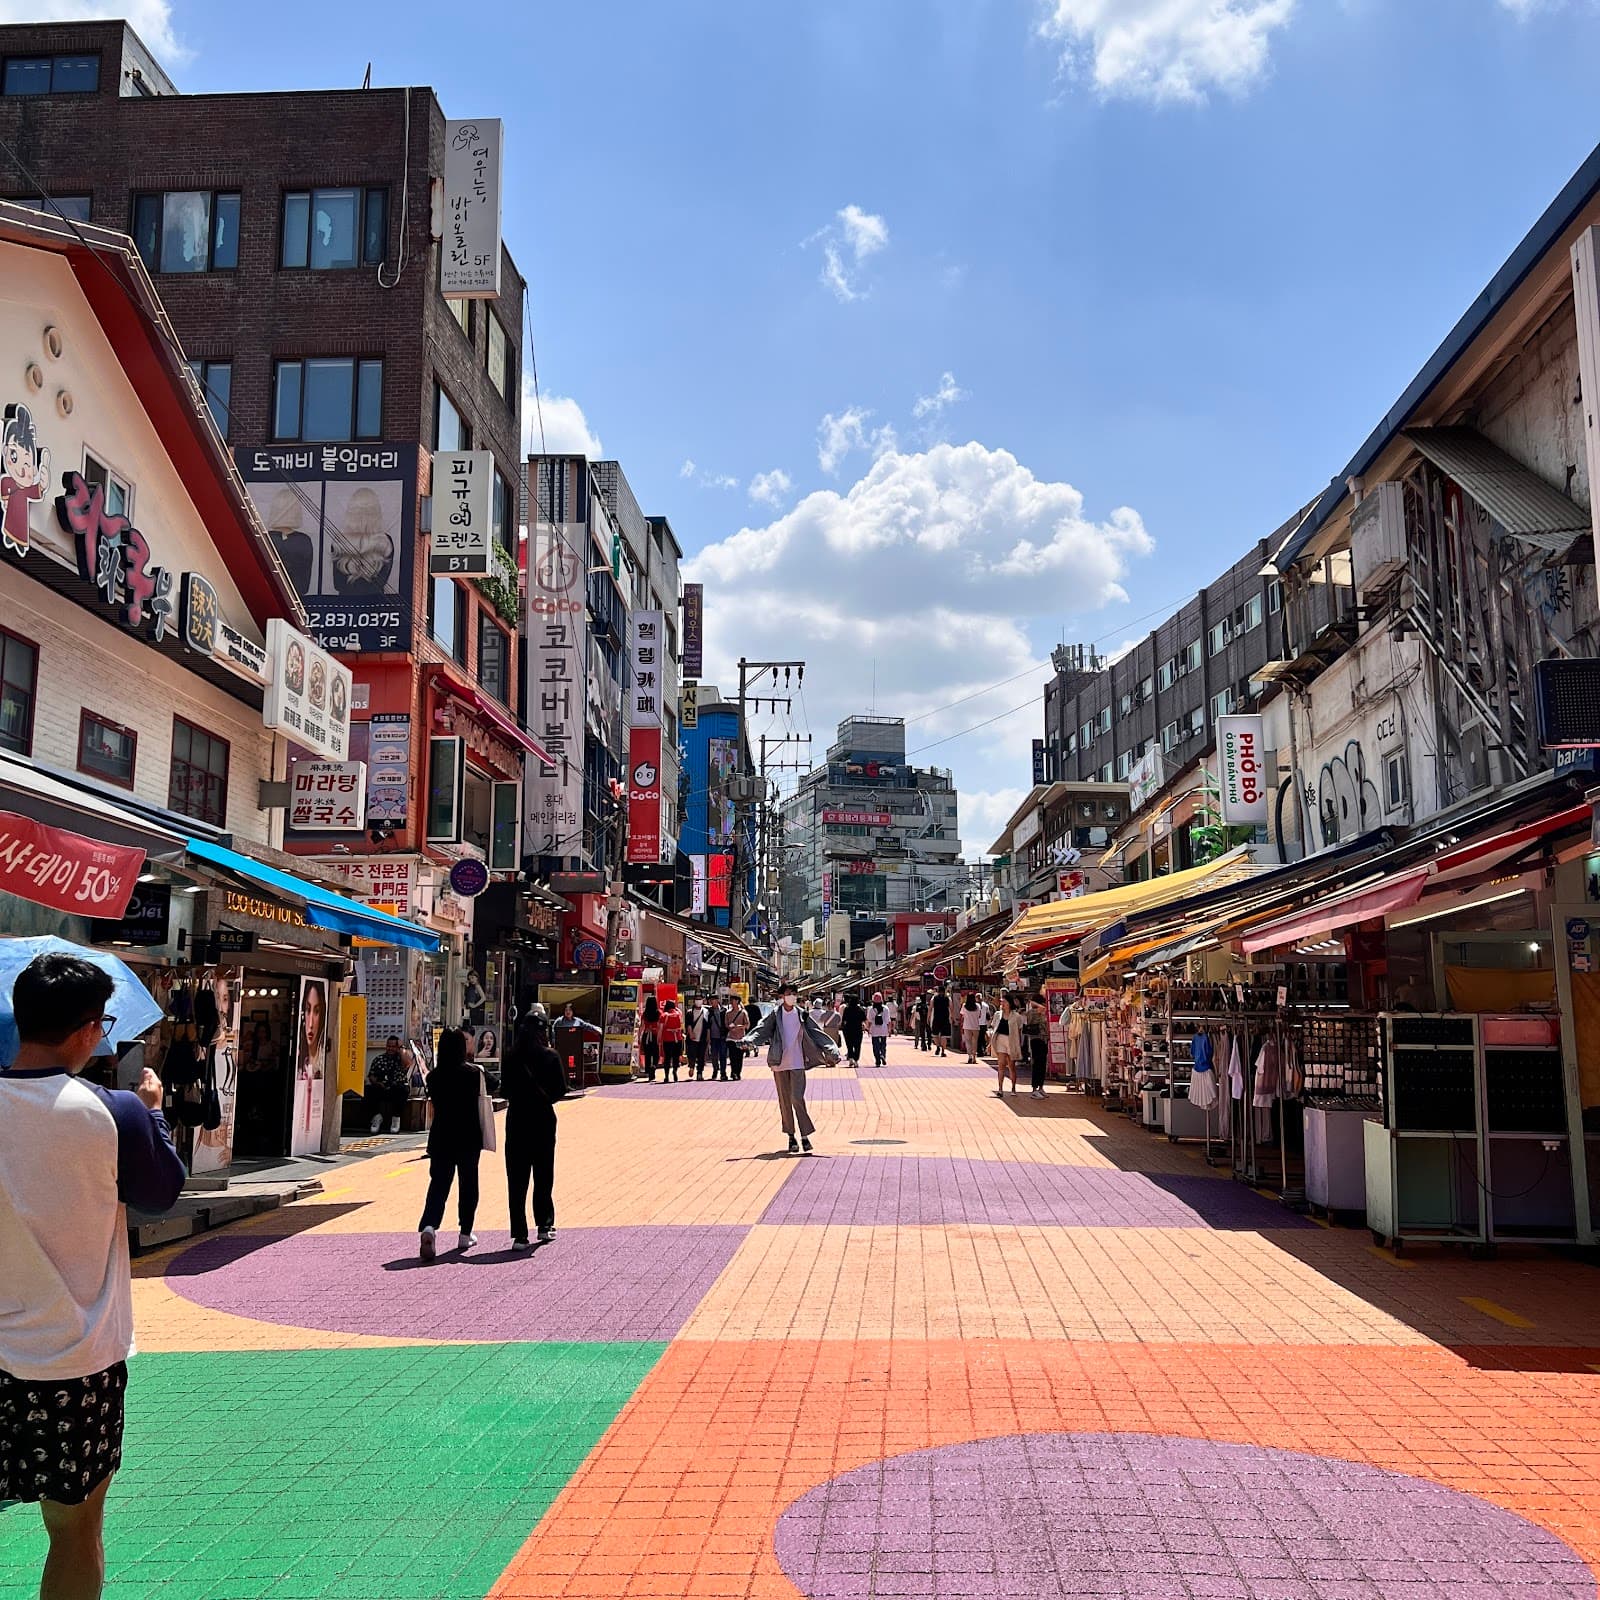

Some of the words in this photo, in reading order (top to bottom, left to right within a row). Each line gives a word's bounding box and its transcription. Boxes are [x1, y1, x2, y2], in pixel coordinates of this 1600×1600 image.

[450, 196, 472, 266] 바이올린
[474, 254, 491, 266] 5F
[253, 451, 313, 472] 도깨비
[320, 446, 398, 473] 붙임머리
[449, 459, 472, 527] 피규어
[435, 532, 484, 549] 프렌즈
[449, 557, 469, 571] B1
[379, 635, 397, 647] 3F
[637, 622, 656, 714] 힐링카페
[538, 624, 573, 787] 코코버블티
[683, 690, 697, 722] 사진
[295, 774, 358, 793] 마라탕
[1242, 777, 1264, 804] BÒ
[543, 793, 563, 808] 홍대
[292, 806, 355, 824] 쌀국수
[530, 811, 577, 825] 메인거리점
[543, 833, 566, 852] 2F
[0, 833, 80, 895] 샤데이
[74, 866, 122, 903] 50%
[367, 863, 409, 879] 전문점
[1571, 925, 1586, 933] ADT
[219, 934, 244, 943] BAG
[373, 951, 400, 966] 1+1
